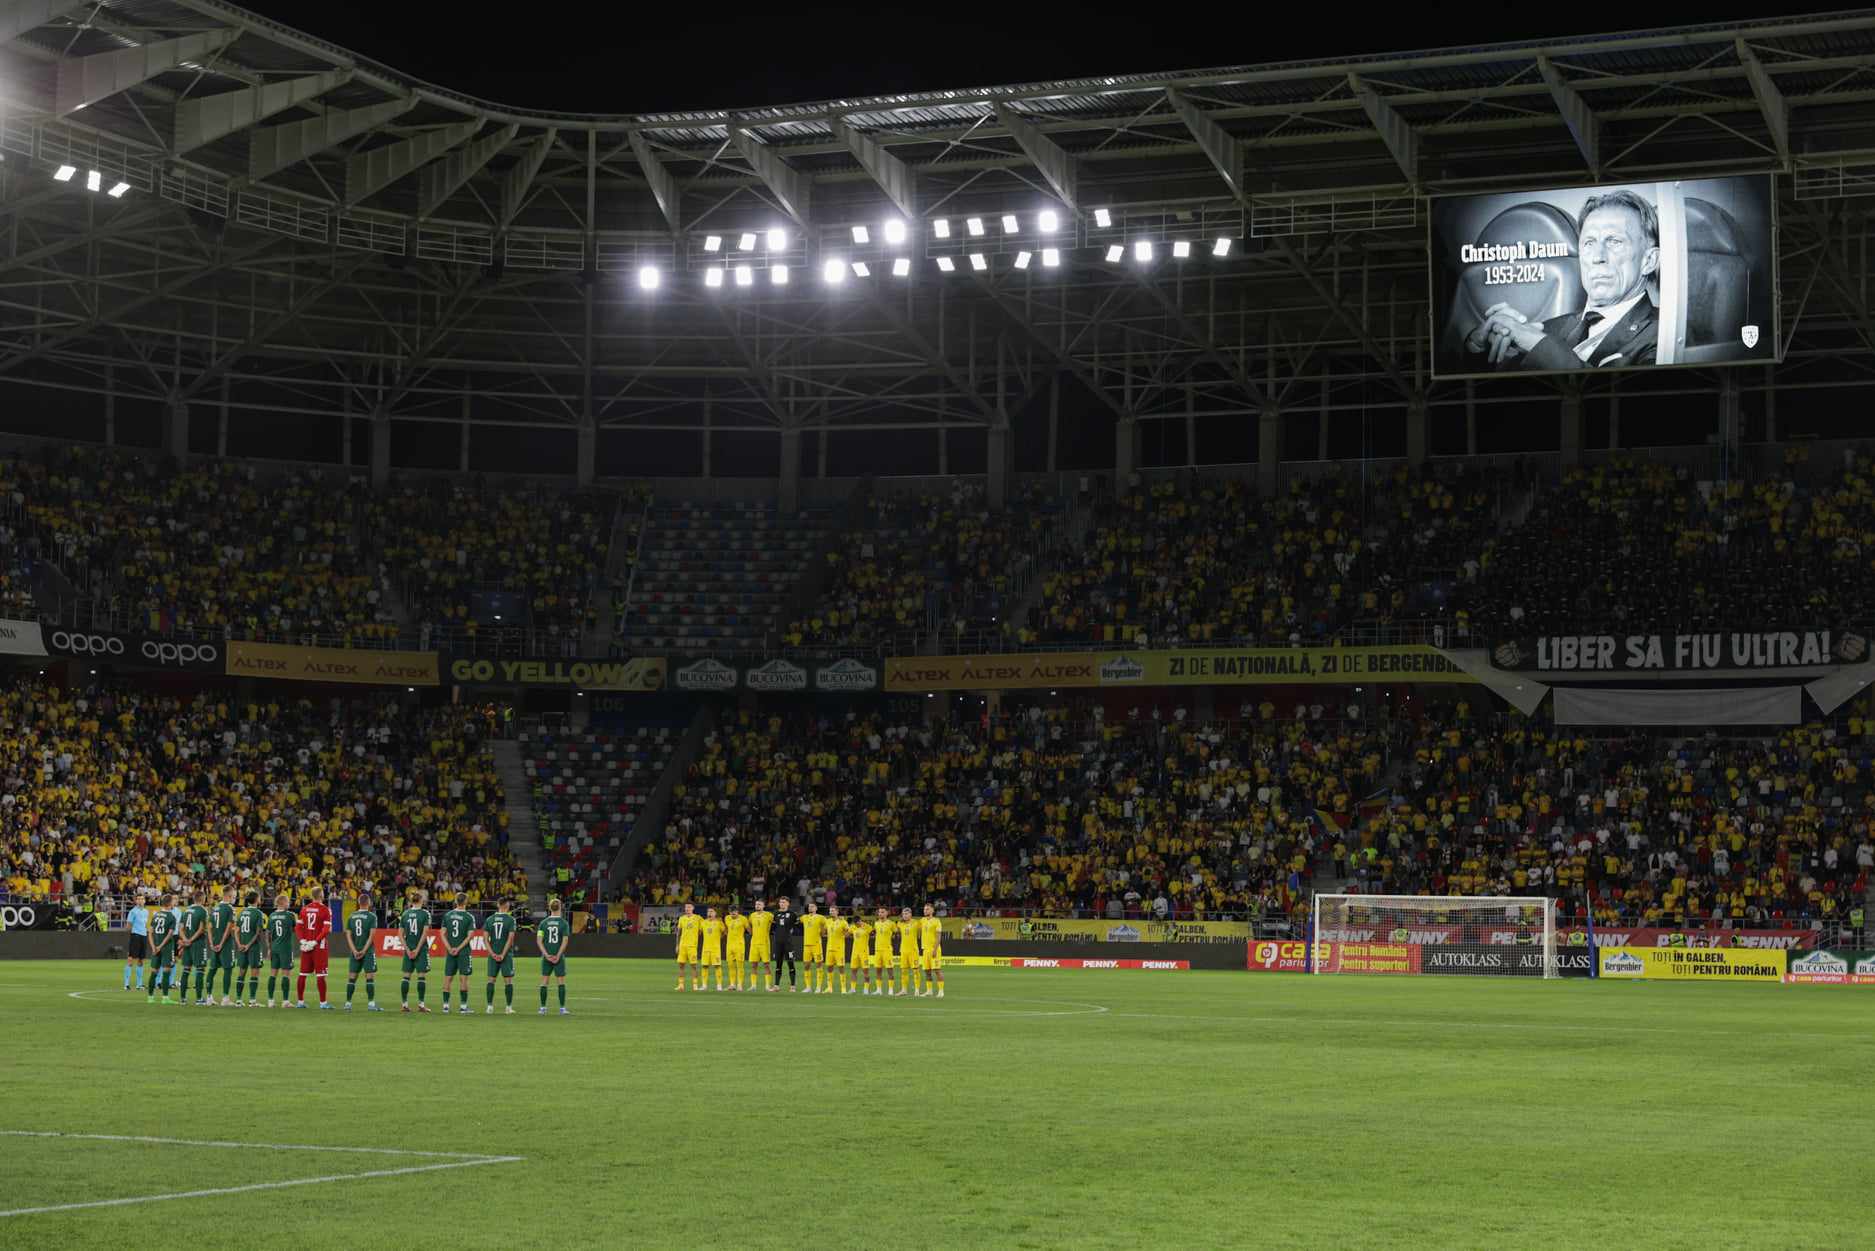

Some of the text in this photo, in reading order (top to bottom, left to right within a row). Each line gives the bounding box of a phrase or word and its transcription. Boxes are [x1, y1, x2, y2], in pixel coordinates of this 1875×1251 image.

[1461, 241, 1568, 263] Christoph Daum
[1485, 264, 1545, 285] 1953-2024
[52, 631, 124, 656] oppo
[1537, 631, 1832, 669] LIBER SA FIU ULTRA!
[142, 641, 217, 666] oppo
[451, 660, 622, 685] GO YELLOW
[1169, 657, 1185, 676] ZI
[1189, 656, 1209, 675] DE
[1321, 655, 1338, 673] ZI
[1343, 654, 1362, 672] DE
[154, 917, 166, 934] 23
[186, 913, 193, 930] 4
[240, 916, 251, 933] 20
[275, 920, 283, 936] 6
[307, 912, 317, 930] 12
[355, 919, 362, 937] 8
[408, 918, 418, 936] 14
[452, 919, 459, 938] 3
[493, 922, 504, 940] 17
[547, 926, 559, 943] 13
[1024, 960, 1060, 968] PENNY.
[1083, 960, 1119, 968] PENNY.
[1142, 961, 1178, 969] PENNY.
[1429, 954, 1501, 967] AUTOKLASS
[1519, 954, 1591, 968] AUTKLASS
[1604, 961, 1642, 973] Bergenbier
[1795, 964, 1844, 974] BUCOVINA
[1693, 965, 1731, 975] PENTRU
[1734, 964, 1777, 976] ROMÂNIA
